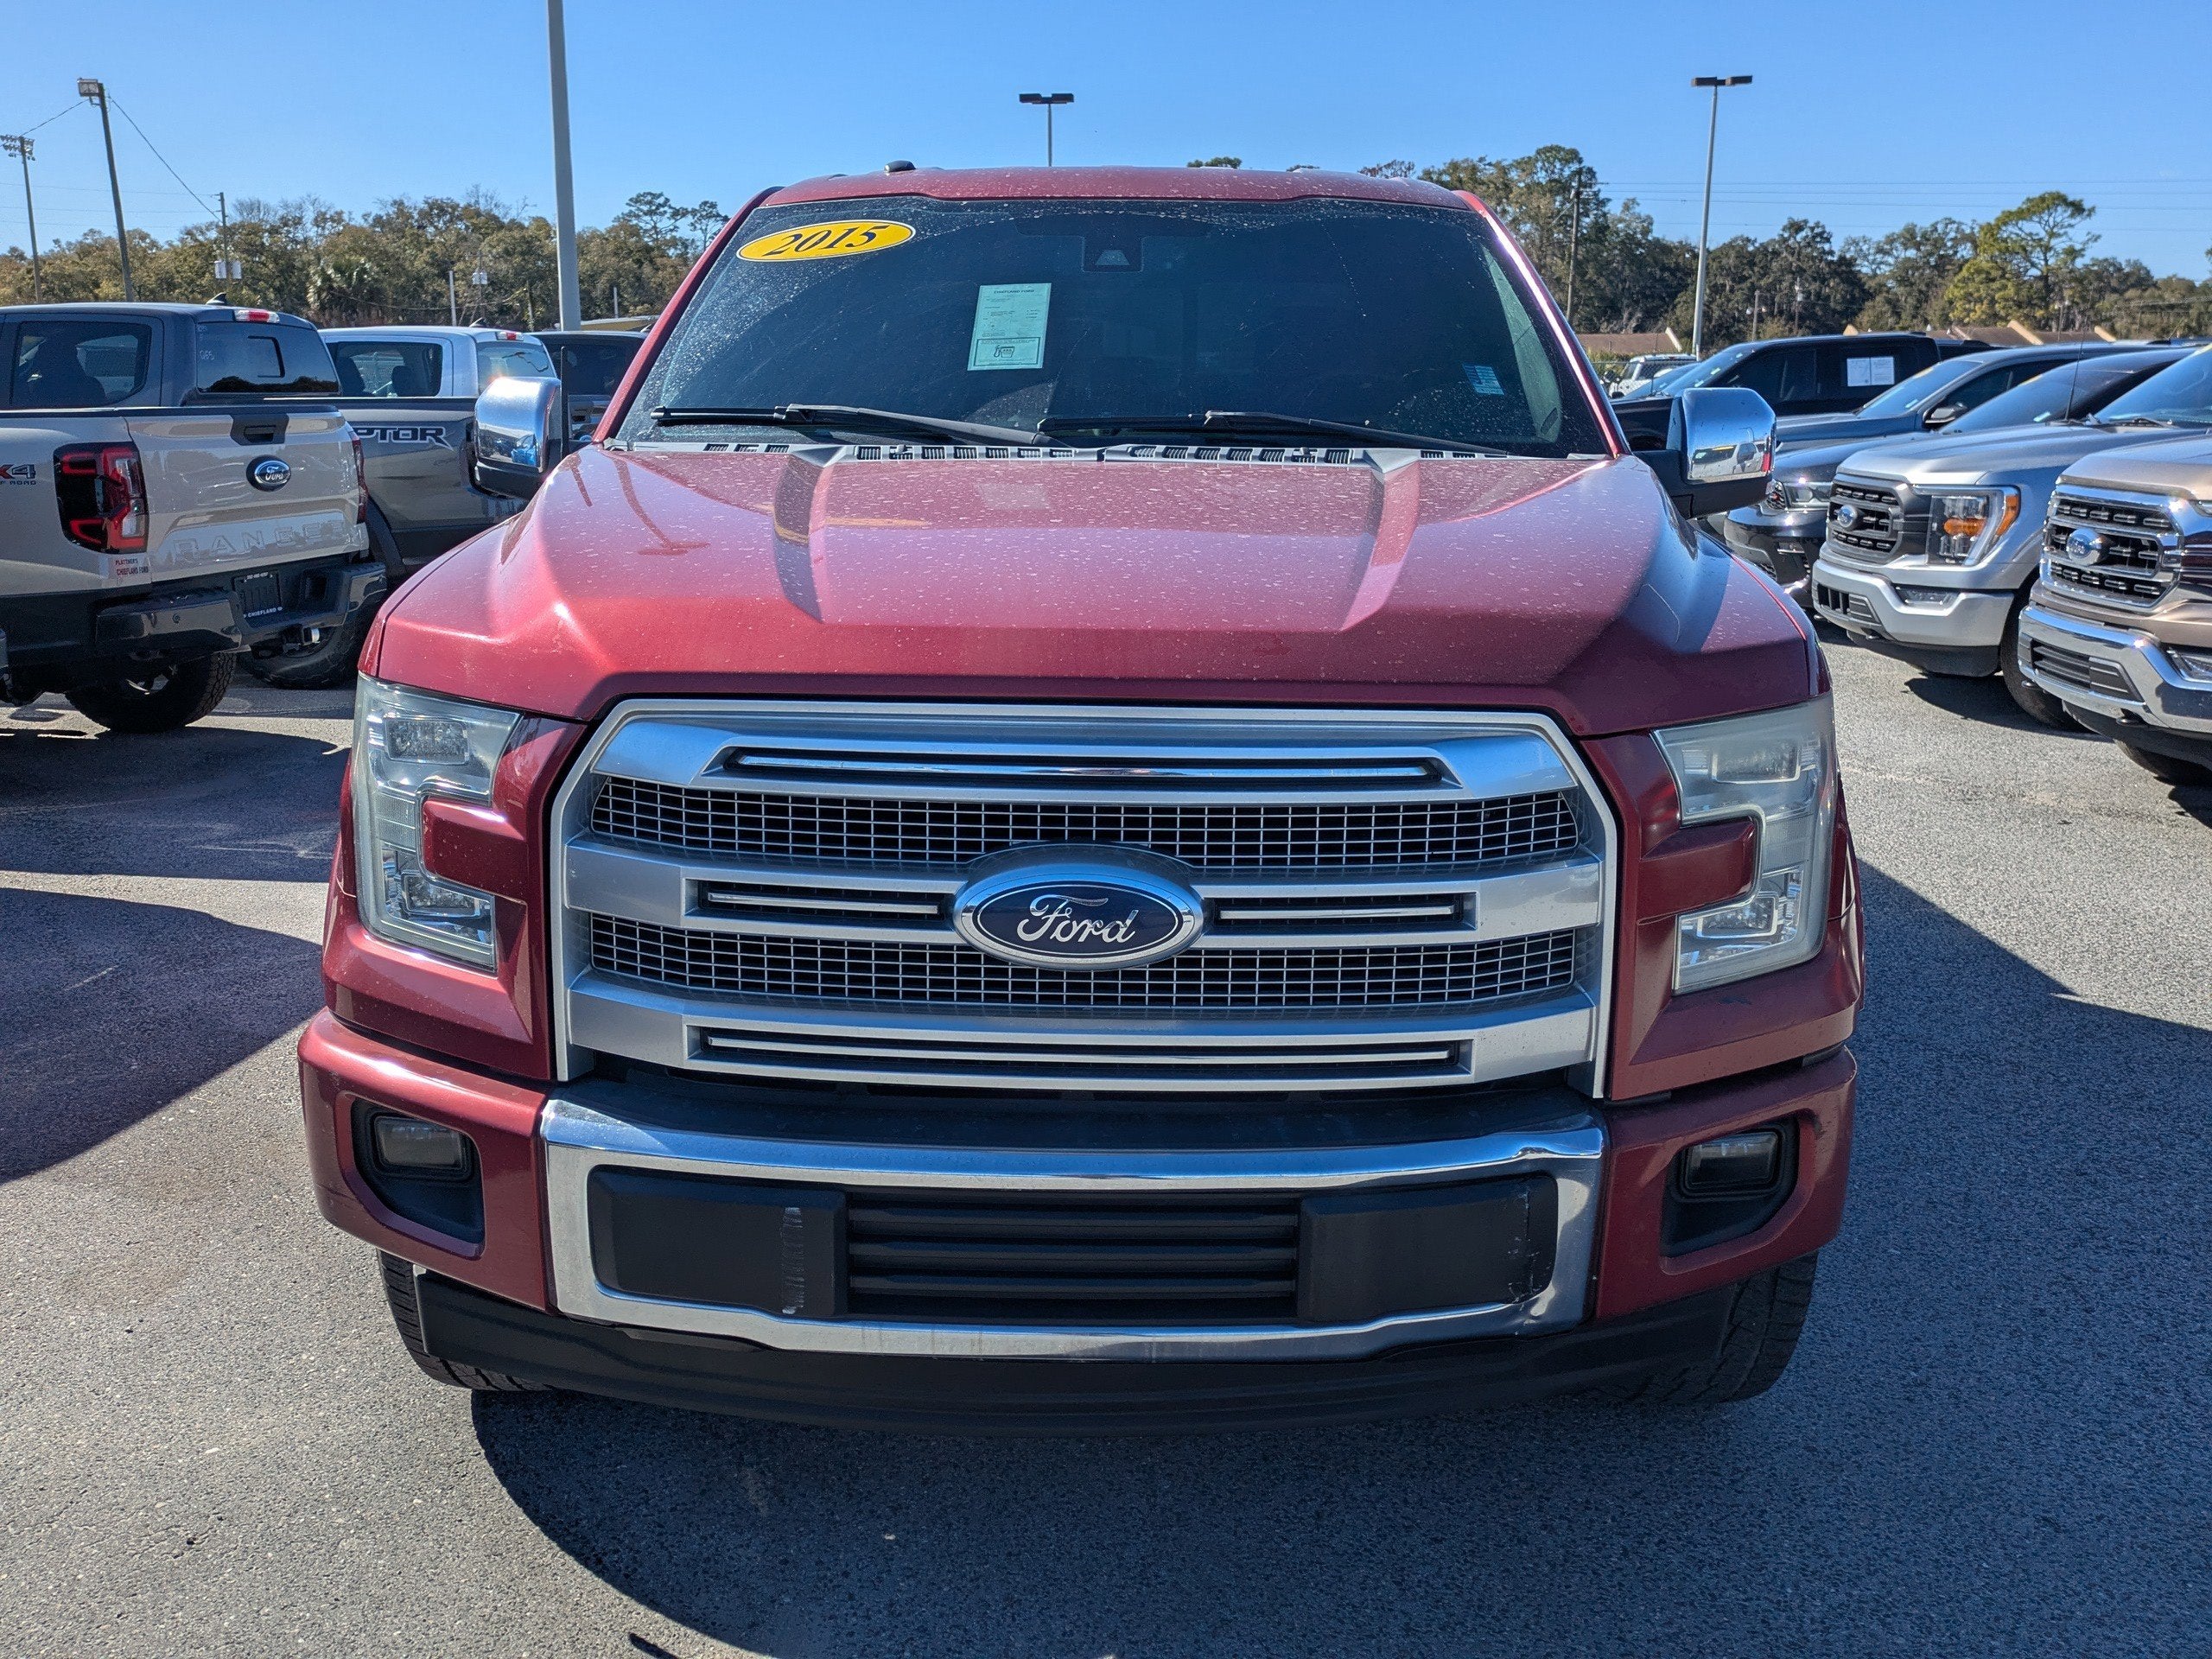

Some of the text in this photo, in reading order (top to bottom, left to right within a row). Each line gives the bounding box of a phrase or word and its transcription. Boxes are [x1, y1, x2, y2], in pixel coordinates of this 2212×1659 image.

[761, 225, 891, 257] 2015
[352, 426, 454, 451] PTOR
[116, 567, 138, 576] CHIEFLAND
[247, 607, 276, 618] CHIEFLAND
[1016, 894, 1140, 944] Ford
